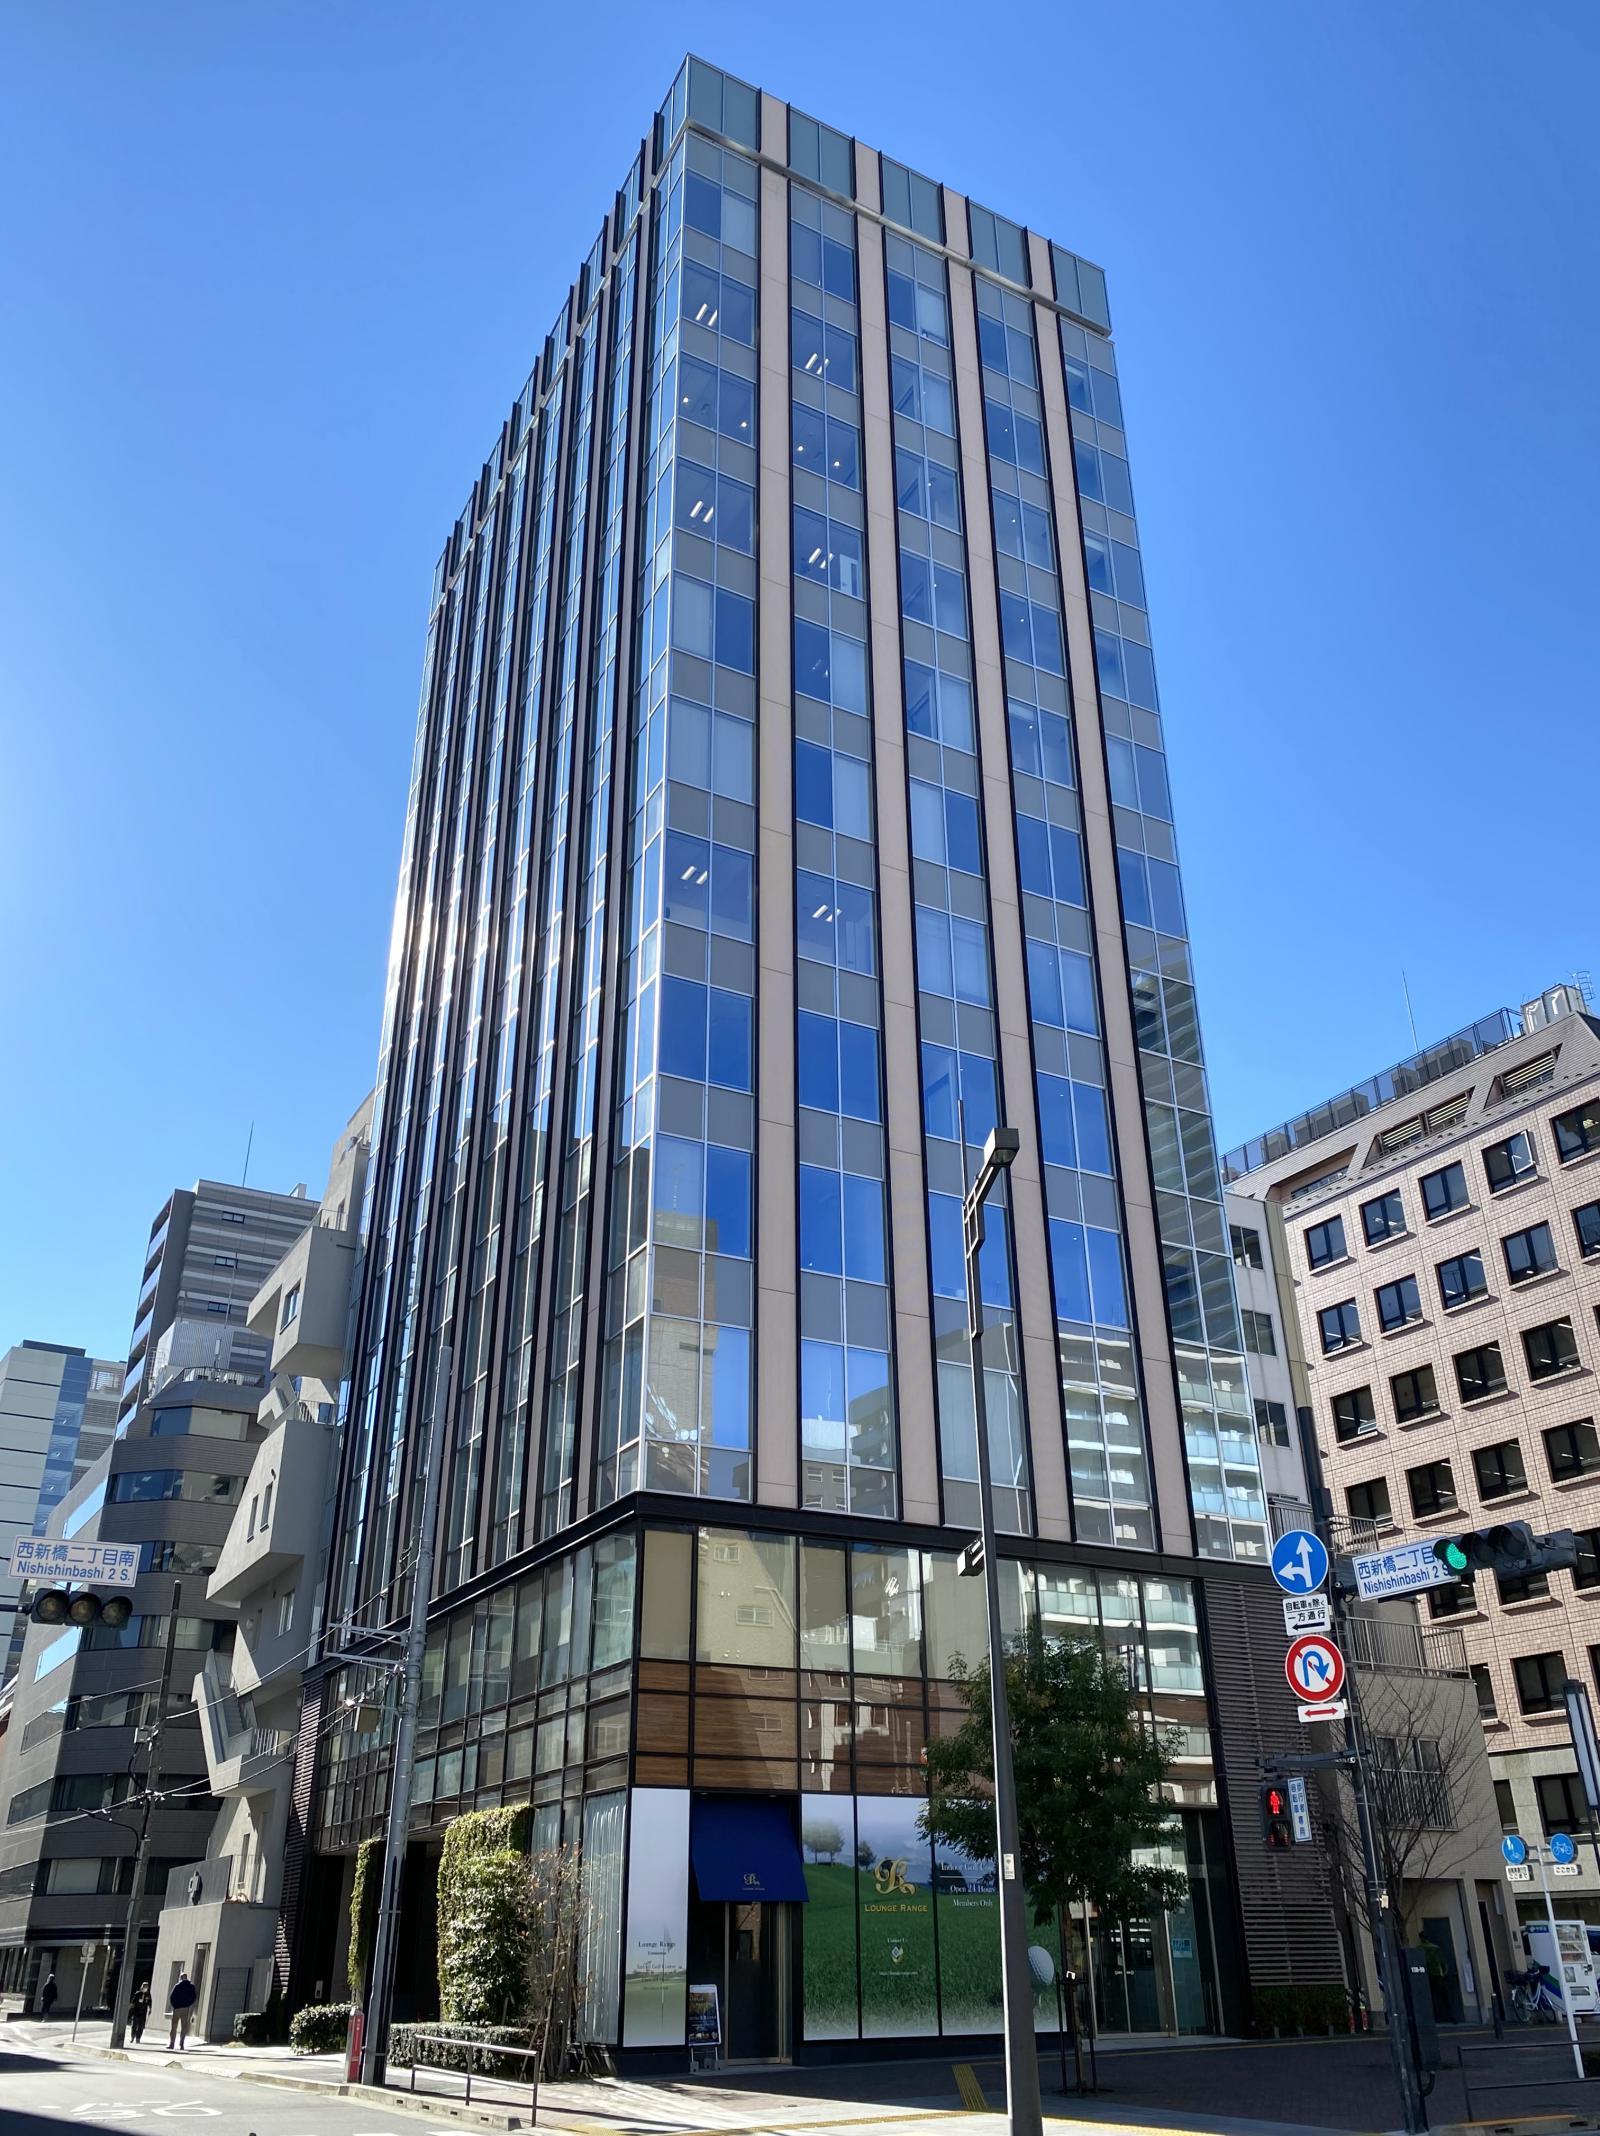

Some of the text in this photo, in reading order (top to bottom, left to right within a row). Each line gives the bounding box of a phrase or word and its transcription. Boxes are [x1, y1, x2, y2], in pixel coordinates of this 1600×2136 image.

[17, 1541, 136, 1567] 西新橋二丁目南
[1357, 1546, 1437, 1579] 西新橋二丁目
[17, 1561, 104, 1579] Nishishinbashi
[108, 1568, 116, 1580] 2
[1364, 1567, 1430, 1594] Nishishinbashi
[1432, 1565, 1440, 1578] 2
[1288, 1610, 1326, 1621] 一方通行
[950, 1884, 966, 1894] Open
[978, 1884, 995, 1893] Hours
[864, 1903, 928, 1912] LOUNGE RANGE
[953, 1898, 979, 1907] Members
